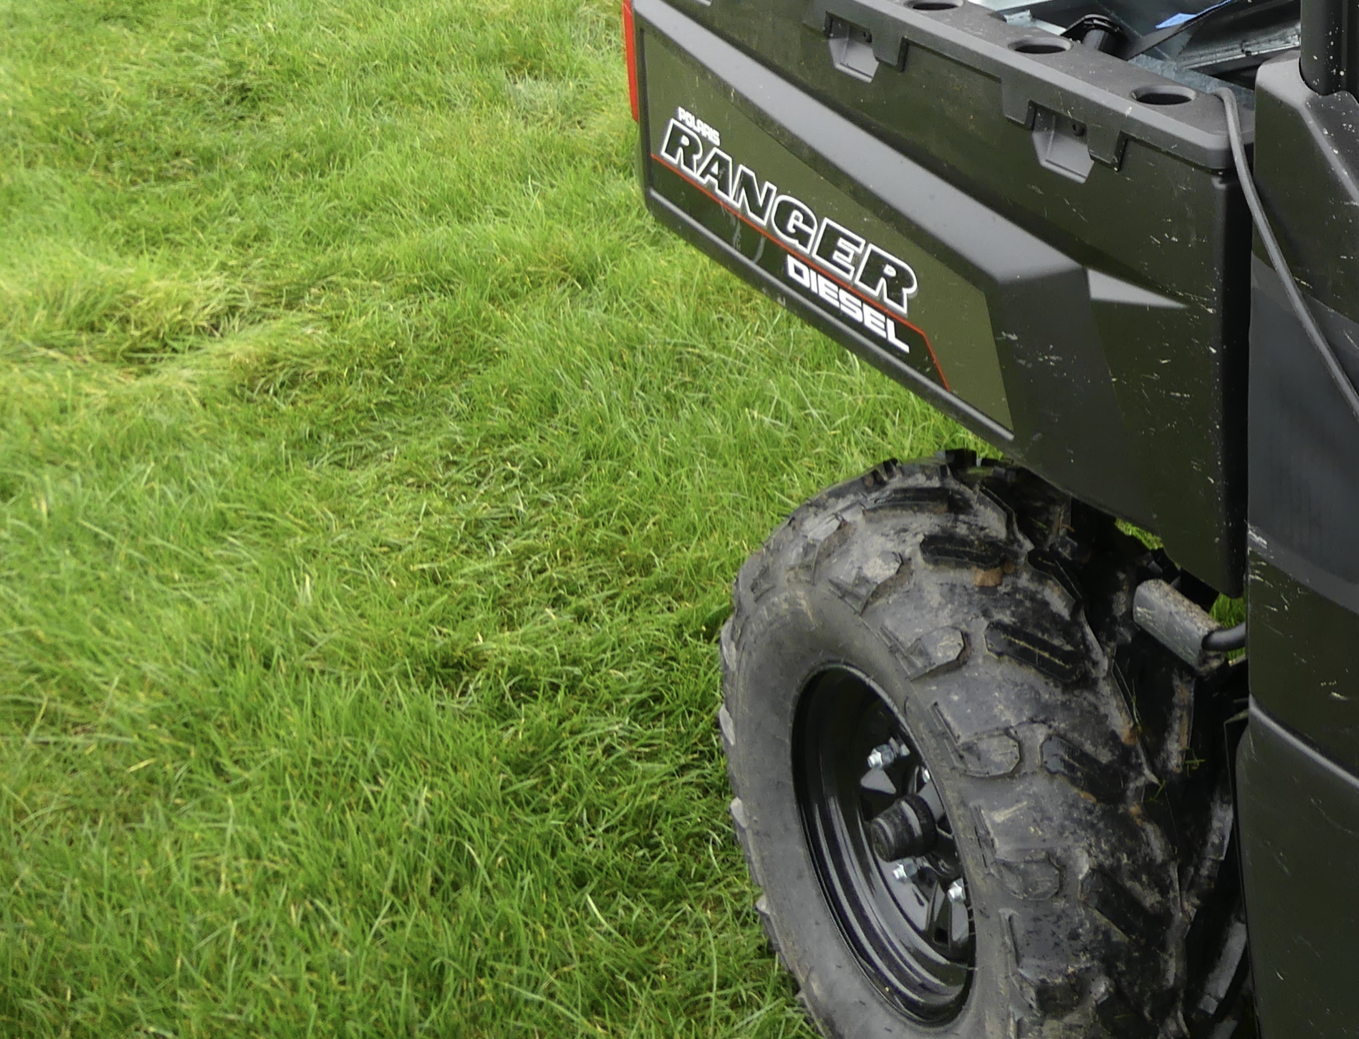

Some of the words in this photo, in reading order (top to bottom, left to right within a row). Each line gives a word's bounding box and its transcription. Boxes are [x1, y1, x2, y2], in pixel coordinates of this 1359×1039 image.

[677, 106, 721, 147] POLARIS
[660, 117, 918, 315] RANGER
[786, 253, 910, 354] DIESEL
